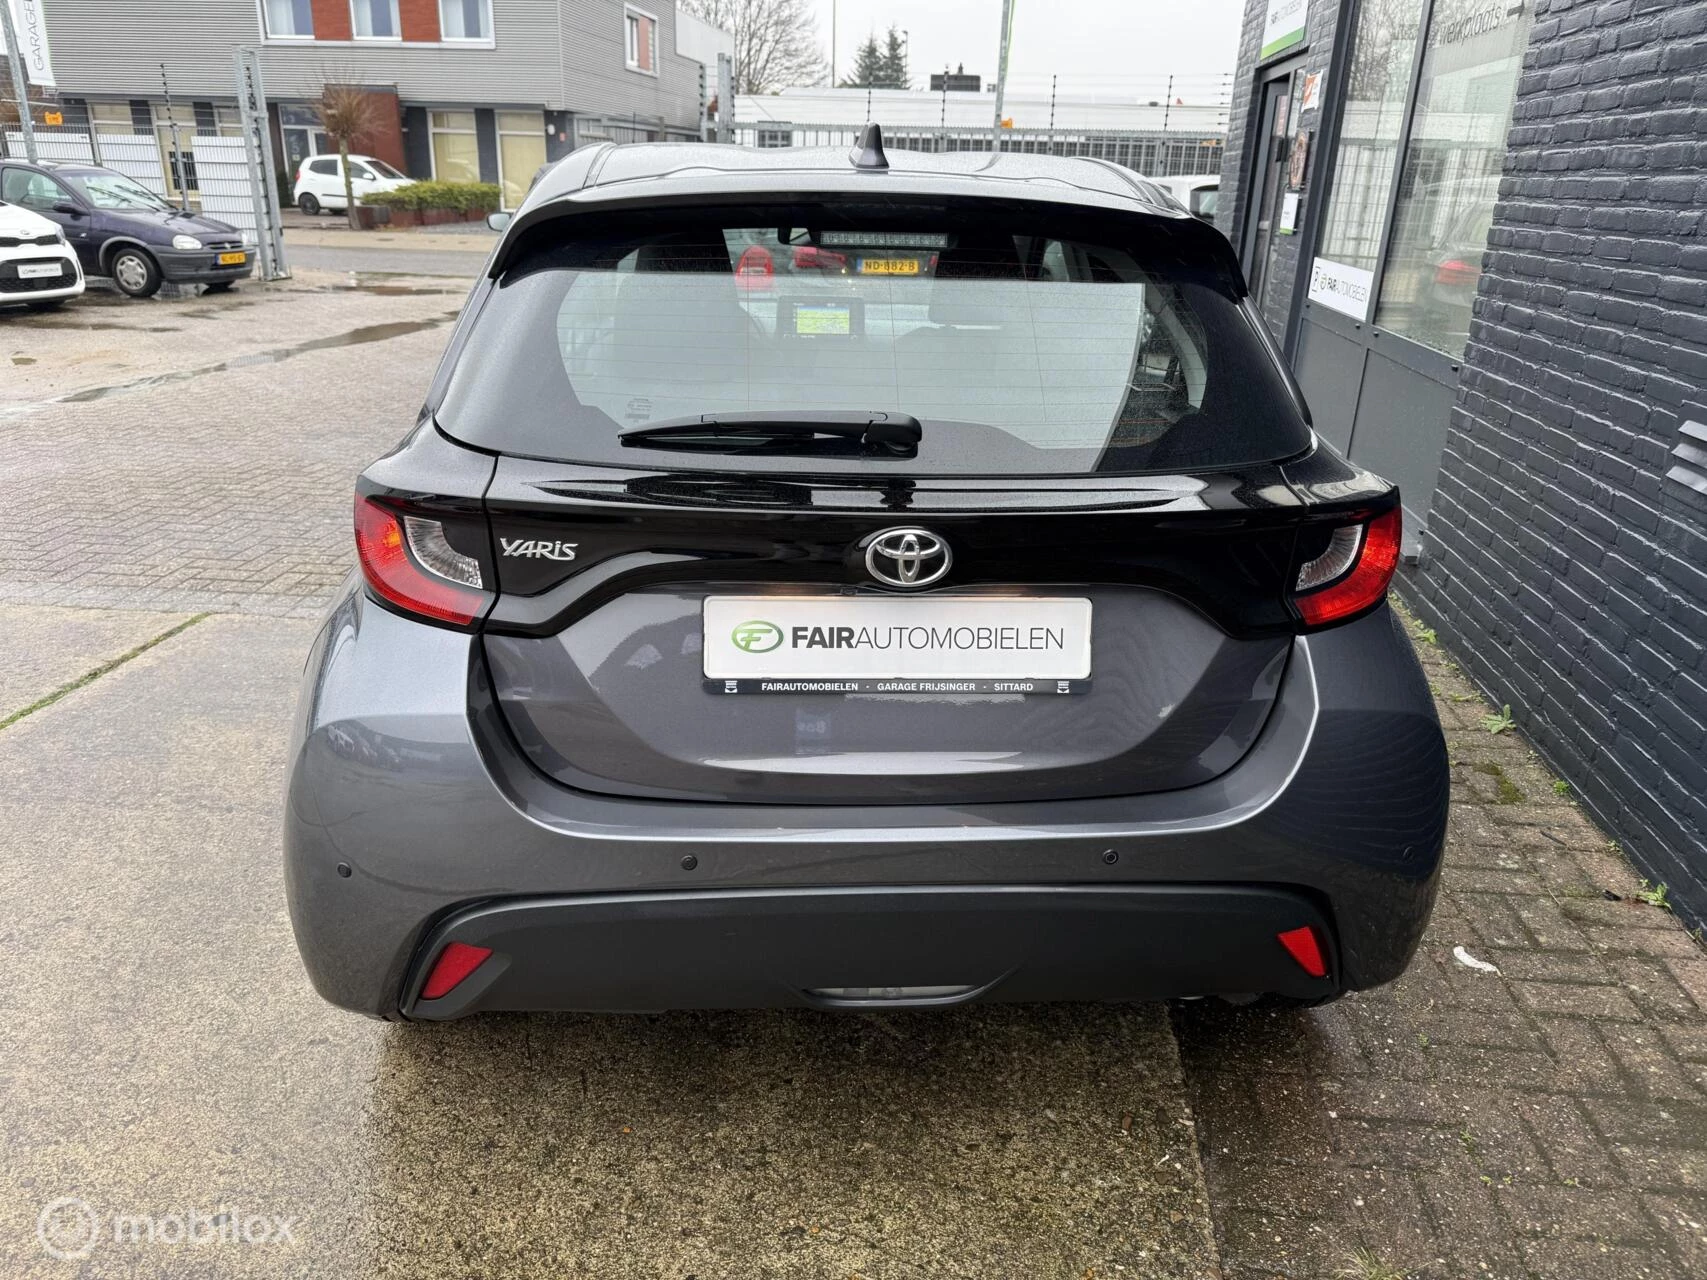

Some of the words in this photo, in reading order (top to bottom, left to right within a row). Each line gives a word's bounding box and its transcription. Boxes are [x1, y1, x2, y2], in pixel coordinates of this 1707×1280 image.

[24, 0, 44, 71] GARAGE
[791, 626, 1064, 650] FAIRAUTOMOBIELEN
[761, 682, 859, 692] FAIRAUTOMOBIELEN
[877, 682, 918, 692] GARAGE
[919, 682, 976, 692] FRIJSINGER
[994, 682, 1034, 692] SITTARD
